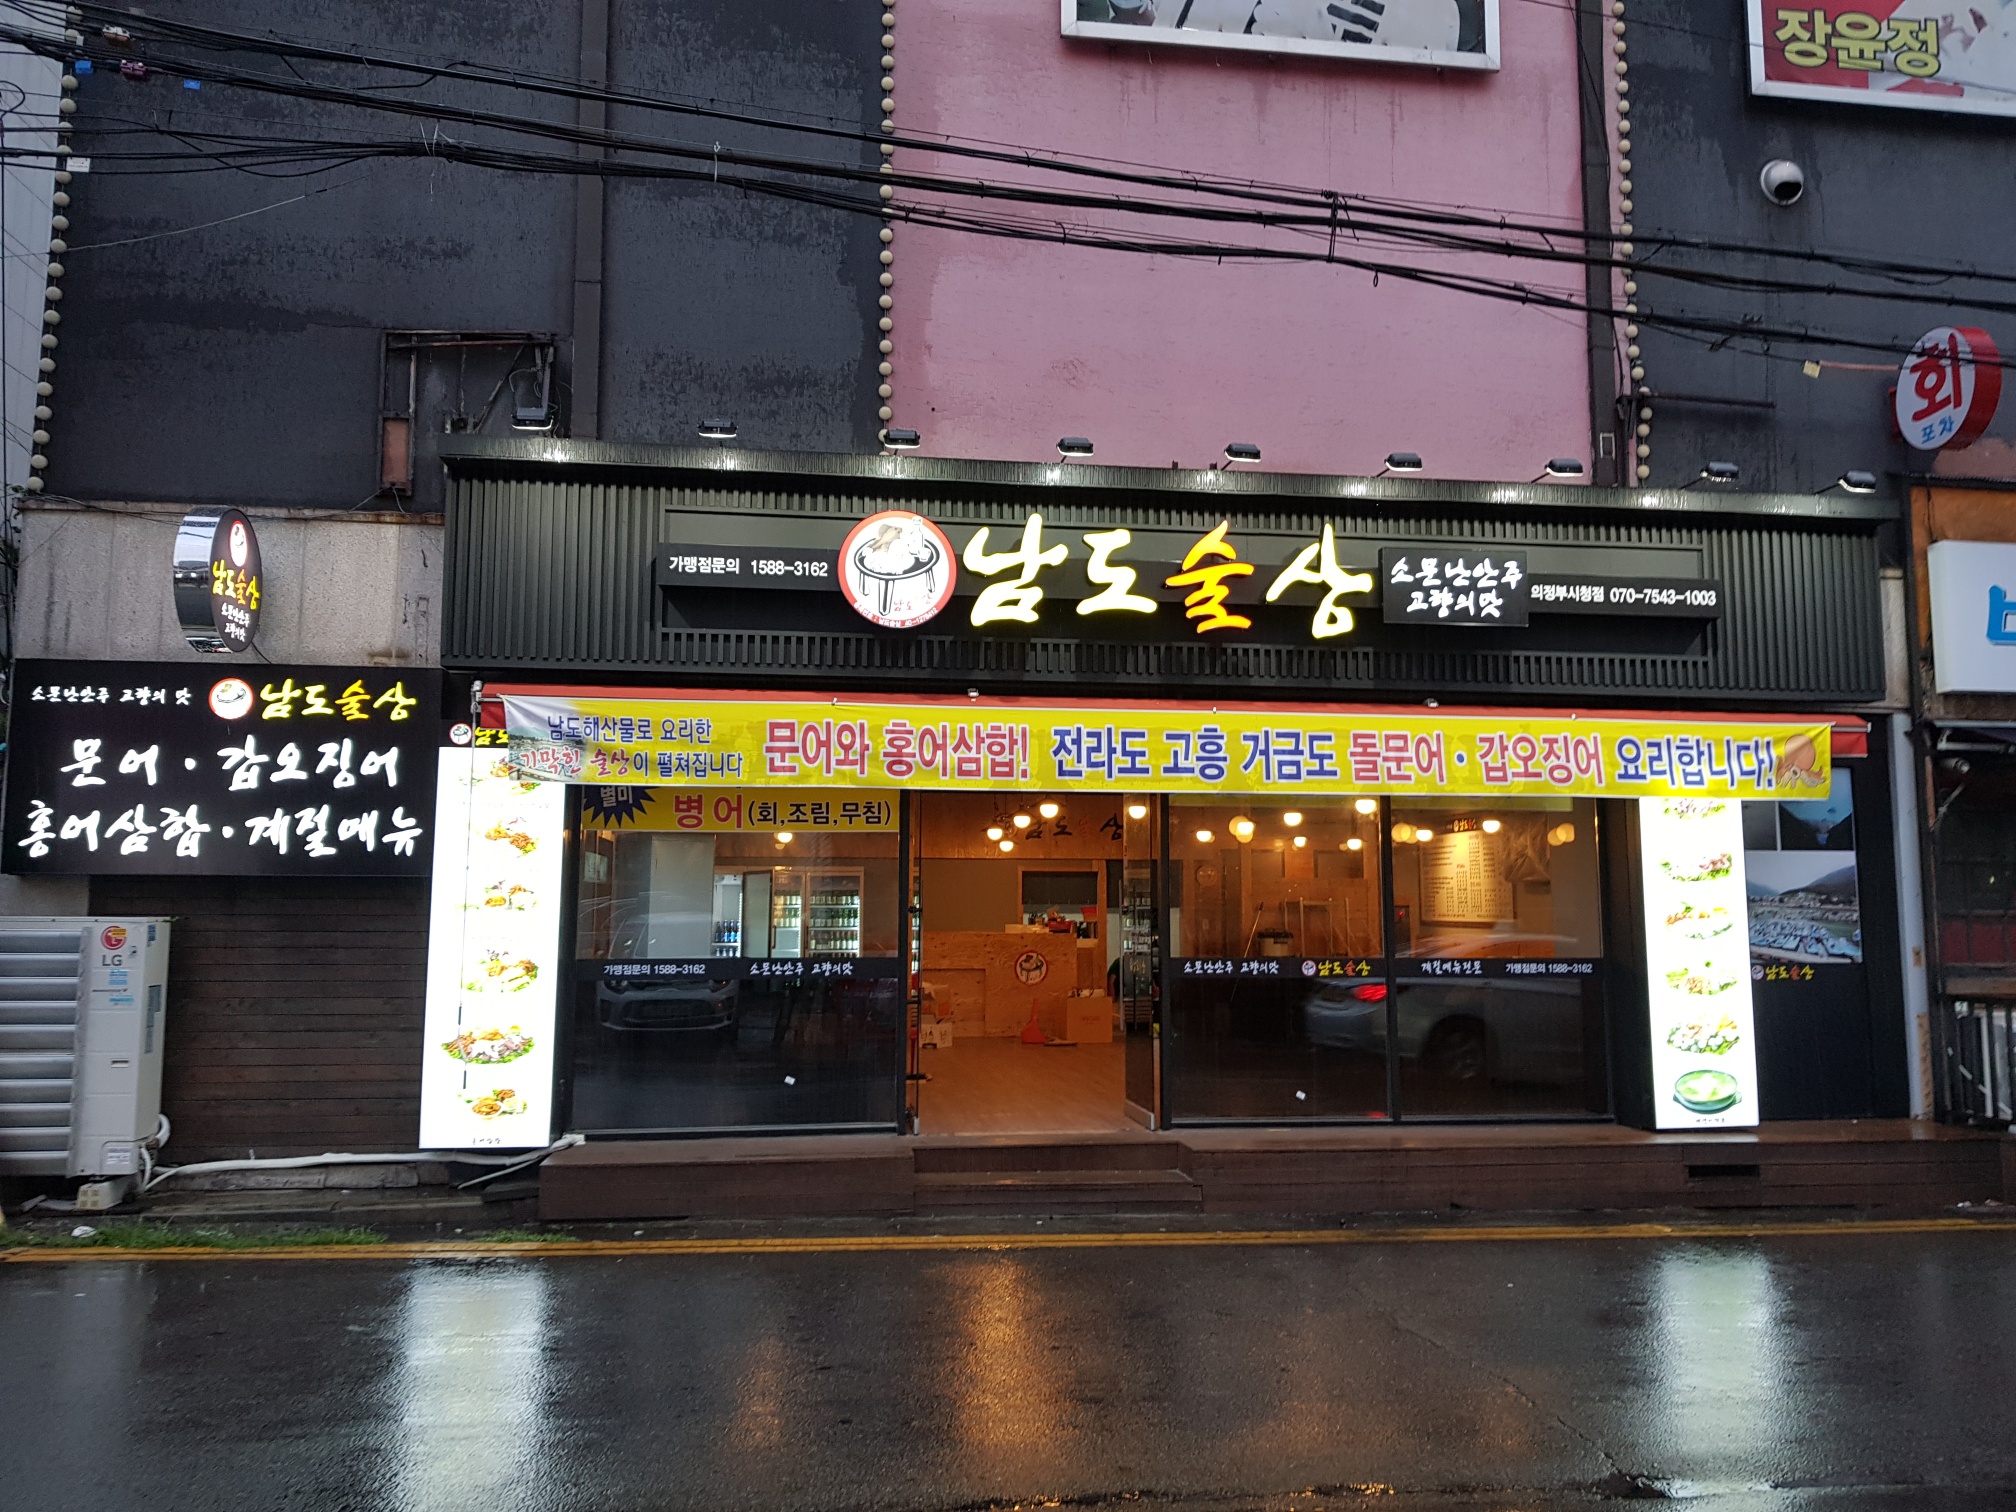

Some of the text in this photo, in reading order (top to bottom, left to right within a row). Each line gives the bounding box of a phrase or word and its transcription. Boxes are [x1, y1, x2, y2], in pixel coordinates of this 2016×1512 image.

[1774, 8, 1941, 77] 장윤정
[1910, 332, 1962, 422] 회
[1921, 415, 1954, 444] 포차
[669, 554, 828, 577] 가맹점문의 1588-3162
[212, 559, 260, 609] 남도술상
[1530, 583, 1717, 607] 의정부시청점 070-7543-1003
[31, 685, 111, 704] 소문난안주
[259, 678, 417, 722] 남도술상
[547, 715, 713, 744] 남도해산물로 요리한
[216, 734, 400, 792] 갑오징어
[520, 749, 582, 775] 기막힌
[656, 751, 743, 779] 펼쳐집니다
[764, 719, 870, 776] 문어와
[881, 720, 1029, 780] 홍어삼합!
[1052, 725, 1150, 778] 전라도
[1161, 726, 1227, 781] 고흥
[1240, 728, 1338, 782] 거금도
[1476, 733, 1605, 785] 갑오징어
[1614, 735, 1774, 789] 요리합니다!
[102, 954, 122, 967] LG
[603, 964, 706, 975] 가맹점문의 1588-3162
[750, 961, 804, 976] 소문난안주
[1184, 960, 1233, 975] 소문난안주
[1318, 959, 1370, 976] 남도술상
[1505, 963, 1593, 973] 가맹점문의 1588-3162
[1765, 964, 1815, 980] 남도술상
